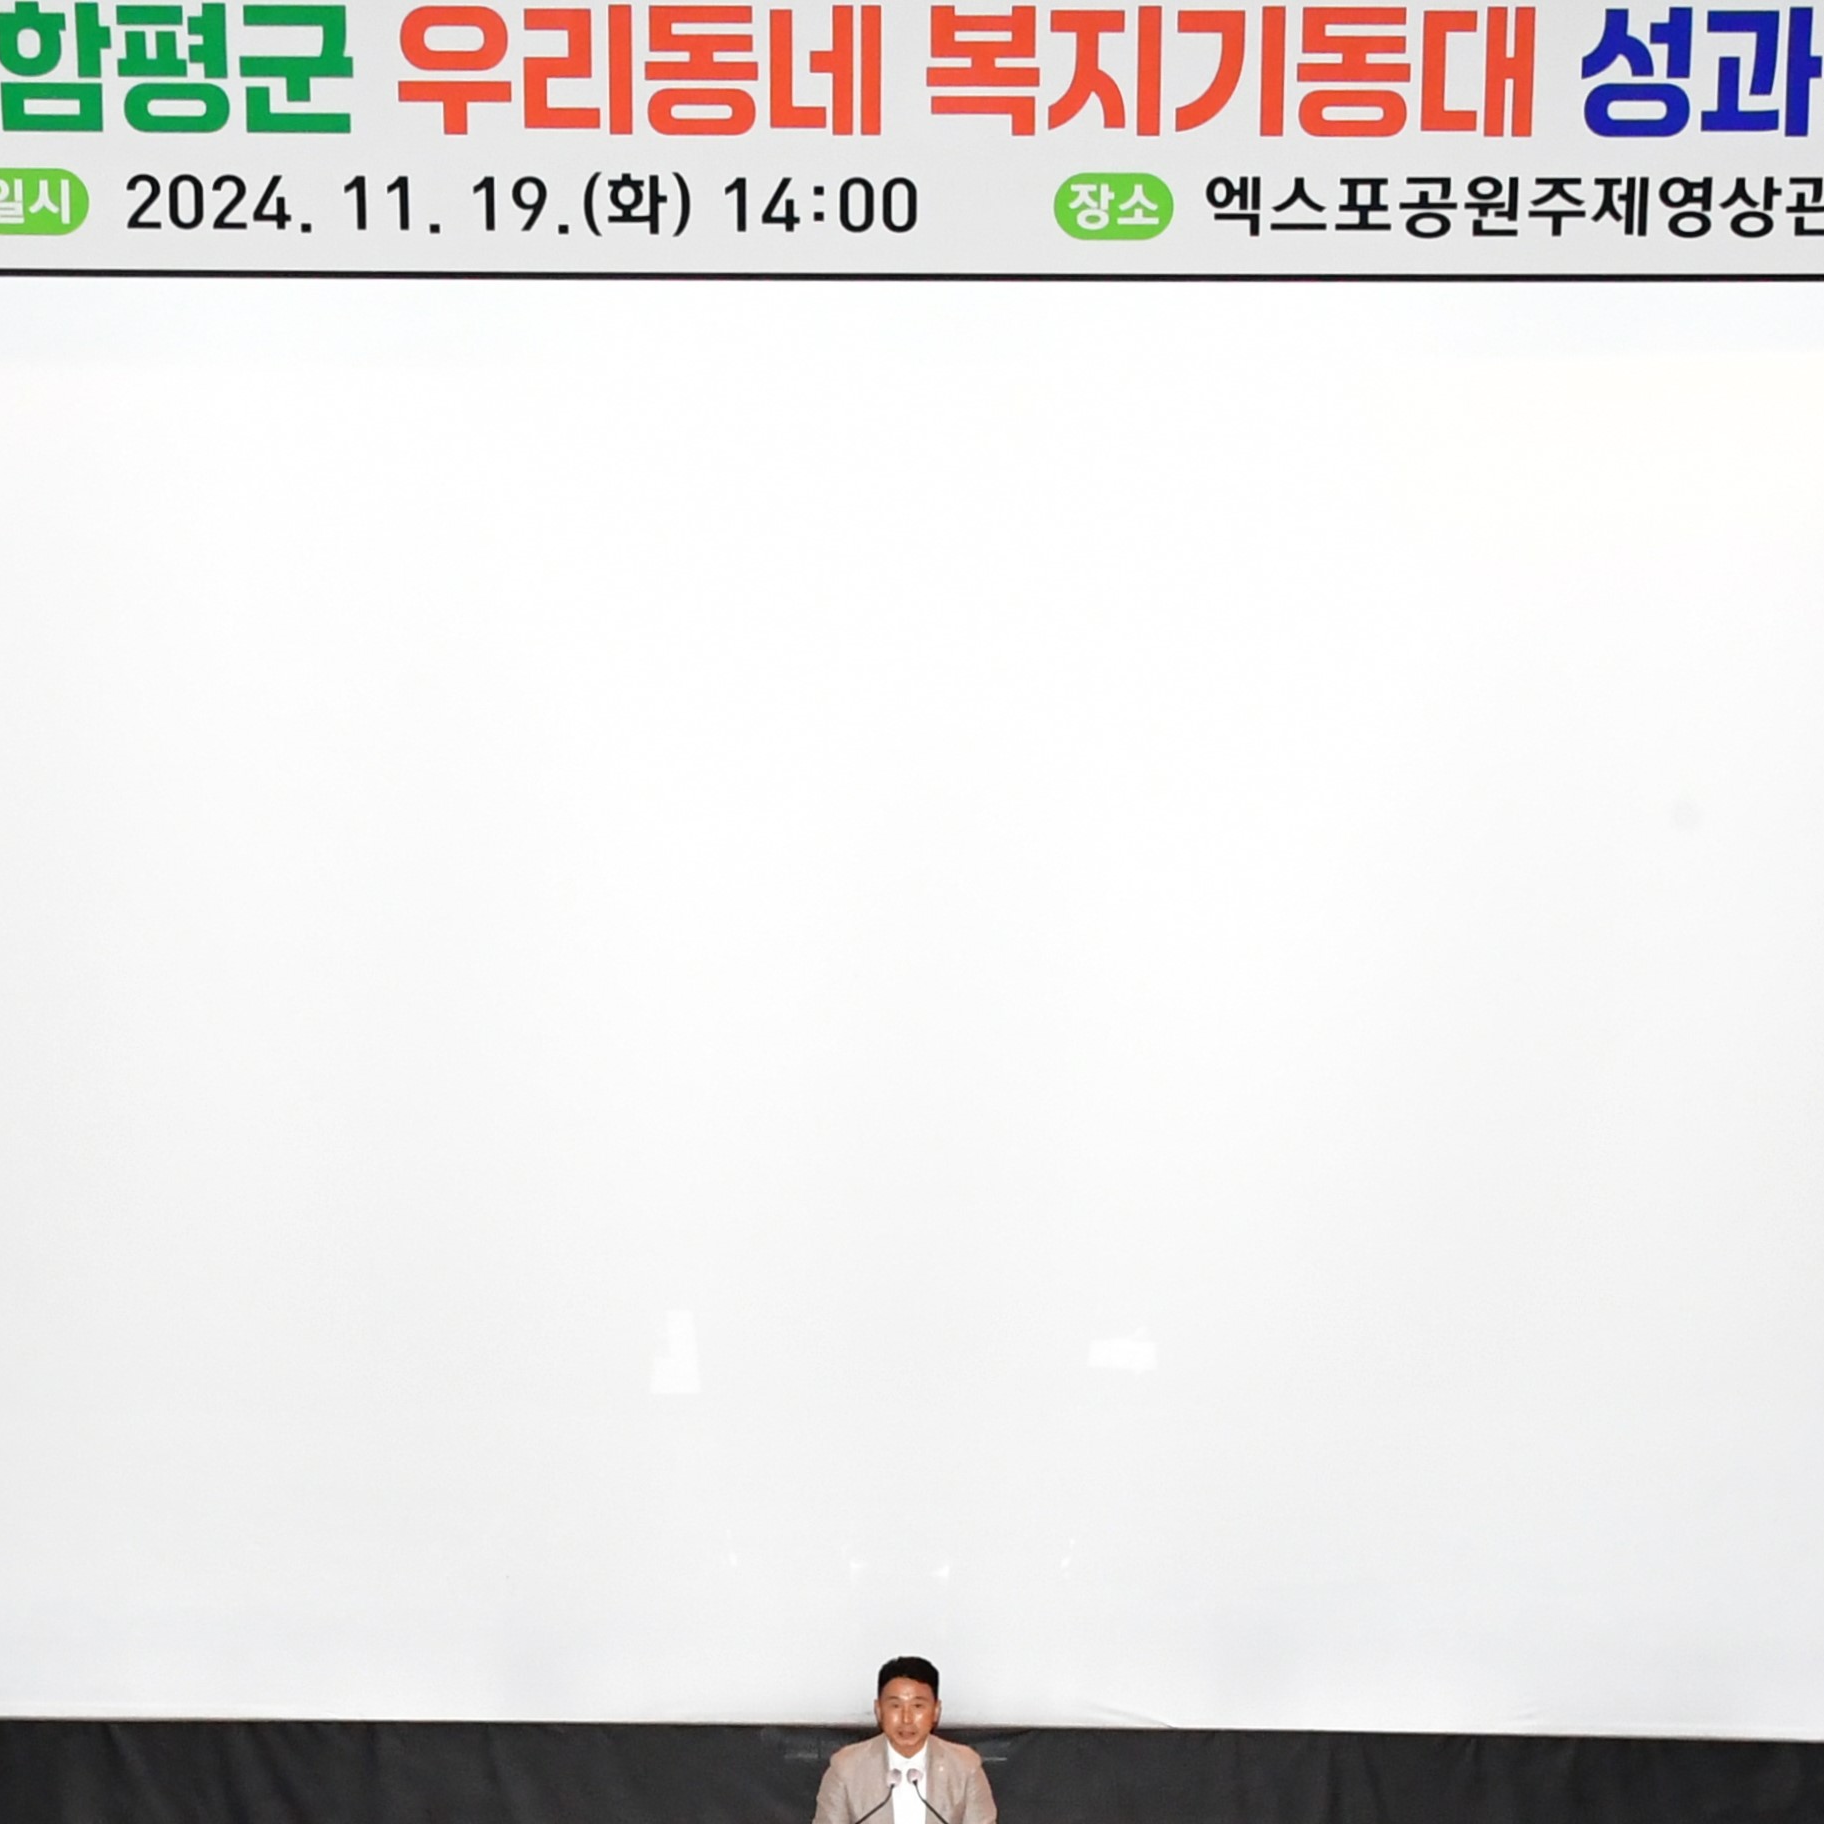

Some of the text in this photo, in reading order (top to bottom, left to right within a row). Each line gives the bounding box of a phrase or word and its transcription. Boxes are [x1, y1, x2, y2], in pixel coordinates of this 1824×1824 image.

[398, 4, 881, 135] 우리동네
[927, 5, 1536, 137] 복지기동대
[127, 172, 917, 236] 2024. 11. 19.(화) 14:00
[1069, 183, 1160, 231] 장소
